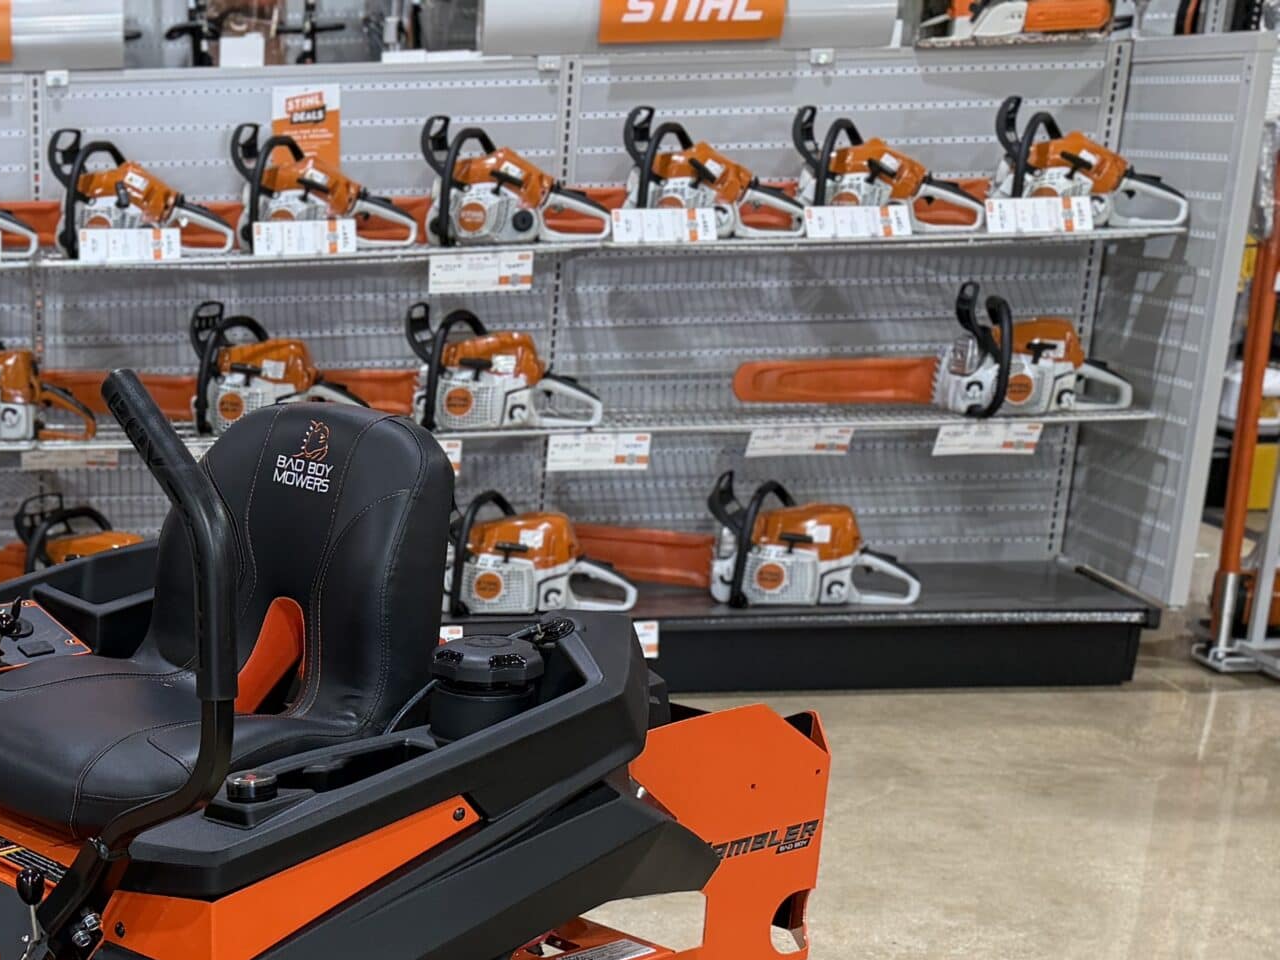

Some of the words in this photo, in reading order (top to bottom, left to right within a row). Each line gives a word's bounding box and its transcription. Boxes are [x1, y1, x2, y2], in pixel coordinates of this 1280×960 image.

[621, 0, 763, 23] STIHL
[287, 94, 322, 111] STIHL
[291, 109, 324, 122] DEALS
[276, 454, 305, 472] BAD
[307, 461, 334, 478] BOY
[273, 468, 330, 493] MOWERS
[707, 819, 819, 859] AMBLER
